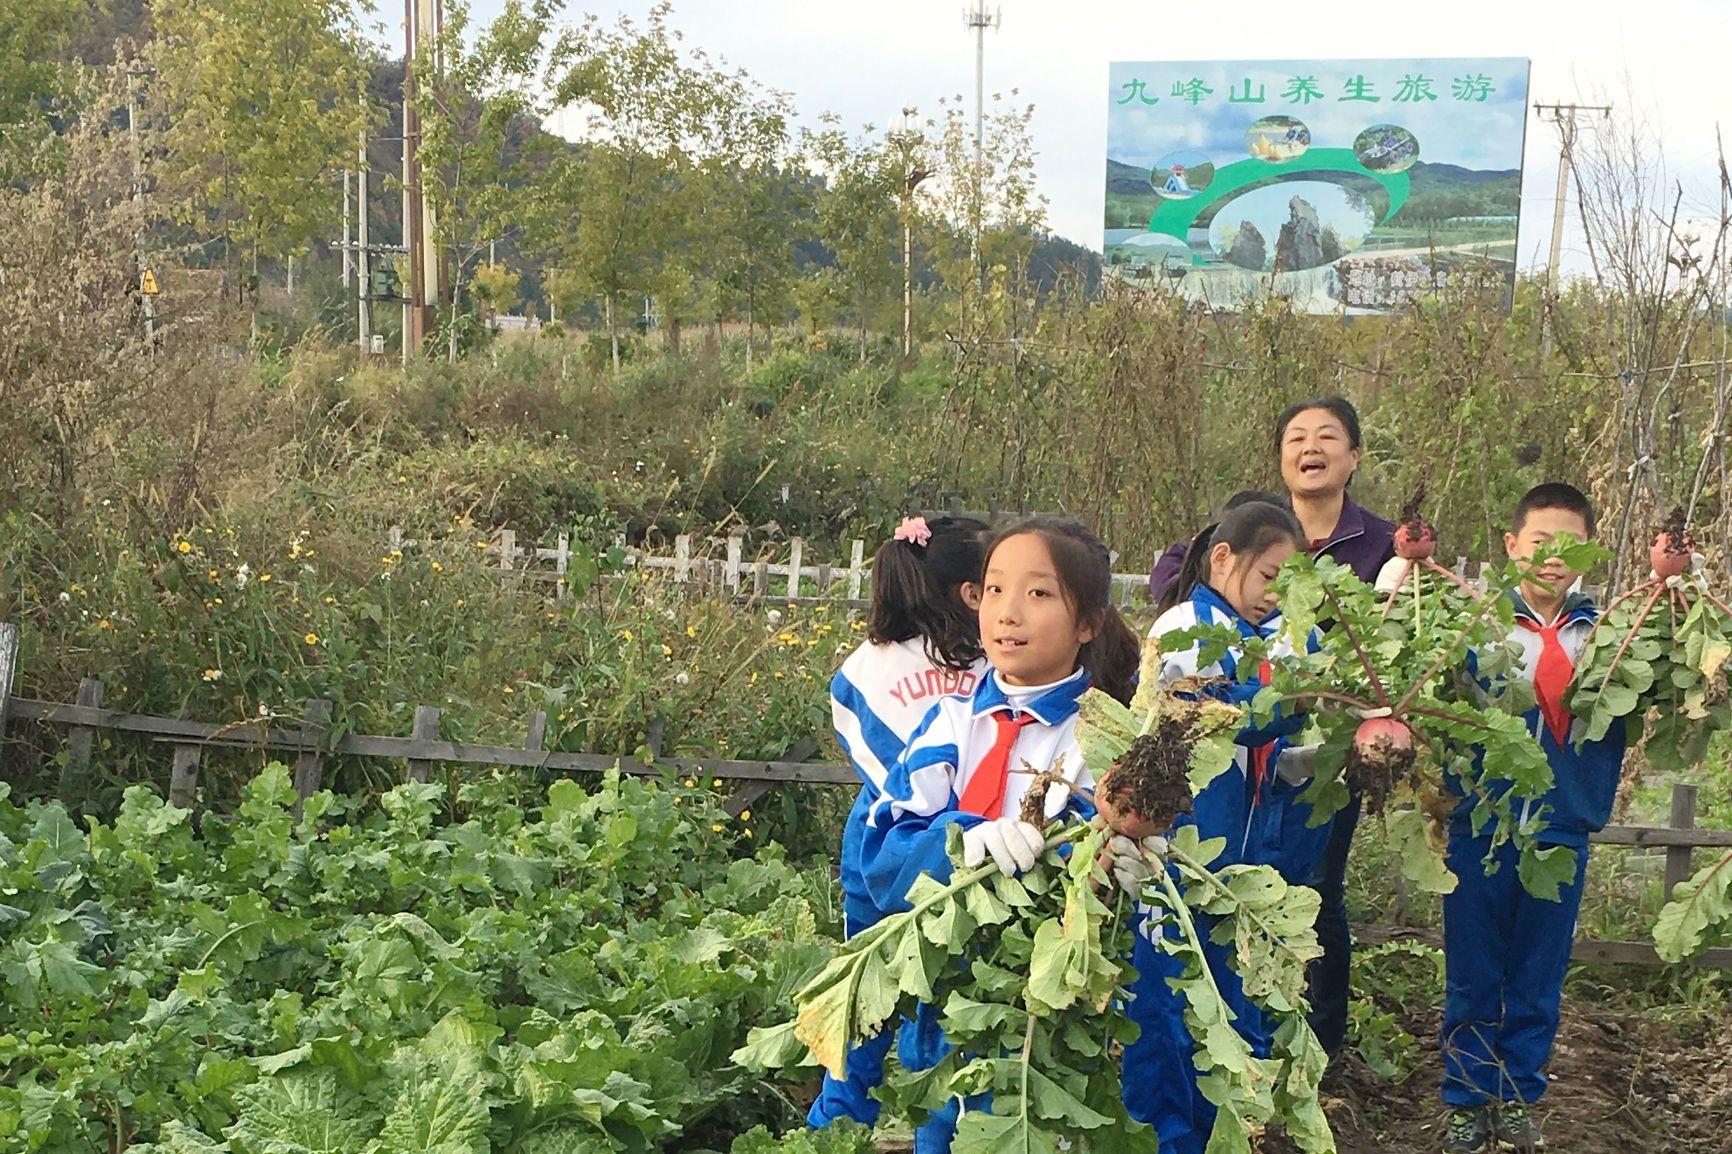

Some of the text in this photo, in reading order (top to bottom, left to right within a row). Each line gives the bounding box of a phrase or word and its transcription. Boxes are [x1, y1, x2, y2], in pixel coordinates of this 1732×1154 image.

[1118, 74, 1497, 106] 九峰山养生旅游
